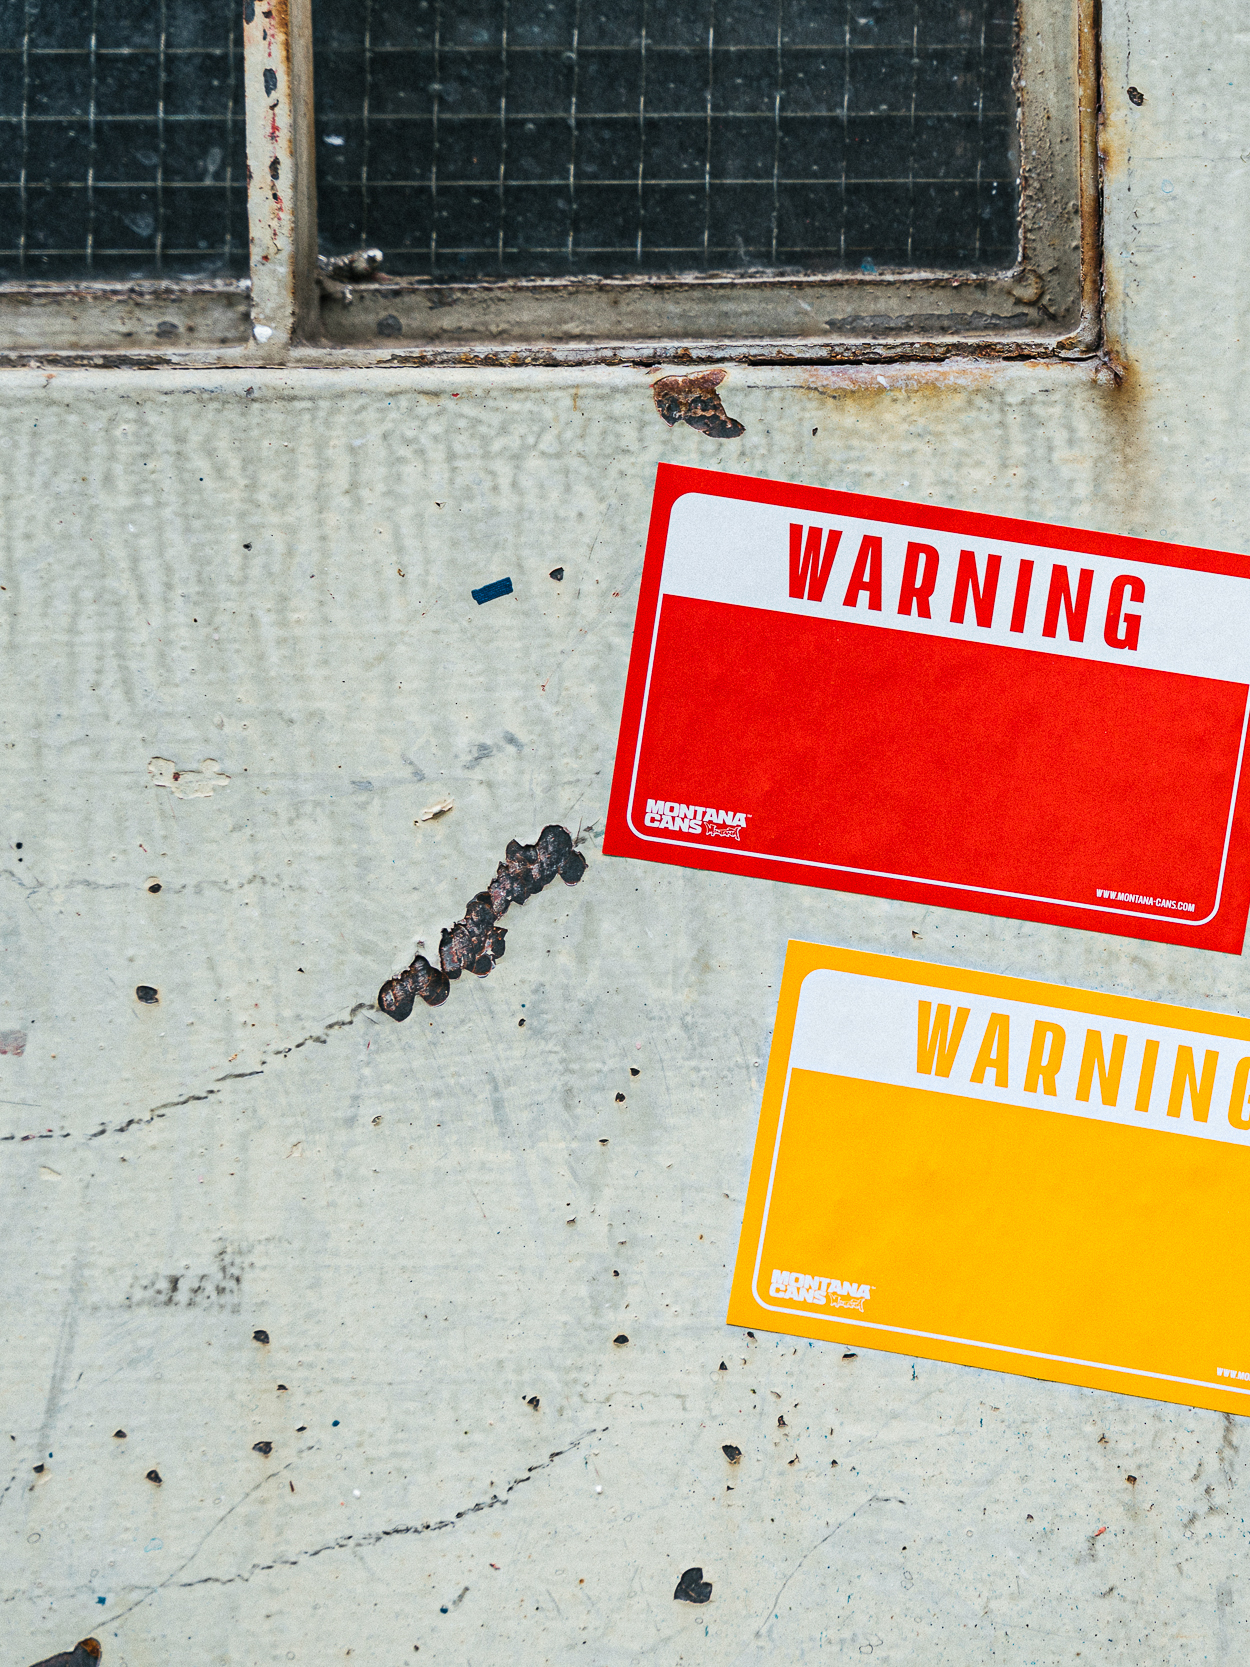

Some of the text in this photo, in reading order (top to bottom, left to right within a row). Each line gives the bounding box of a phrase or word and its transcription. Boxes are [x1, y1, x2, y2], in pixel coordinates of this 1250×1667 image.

[788, 522, 1146, 652] WARNING
[643, 812, 703, 835] CANS
[645, 798, 747, 828] MONTANA
[1095, 888, 1196, 913] WWW.MONTANA-CANS.COM
[768, 1282, 827, 1306] CANS
[770, 1268, 871, 1300] MONTANA
